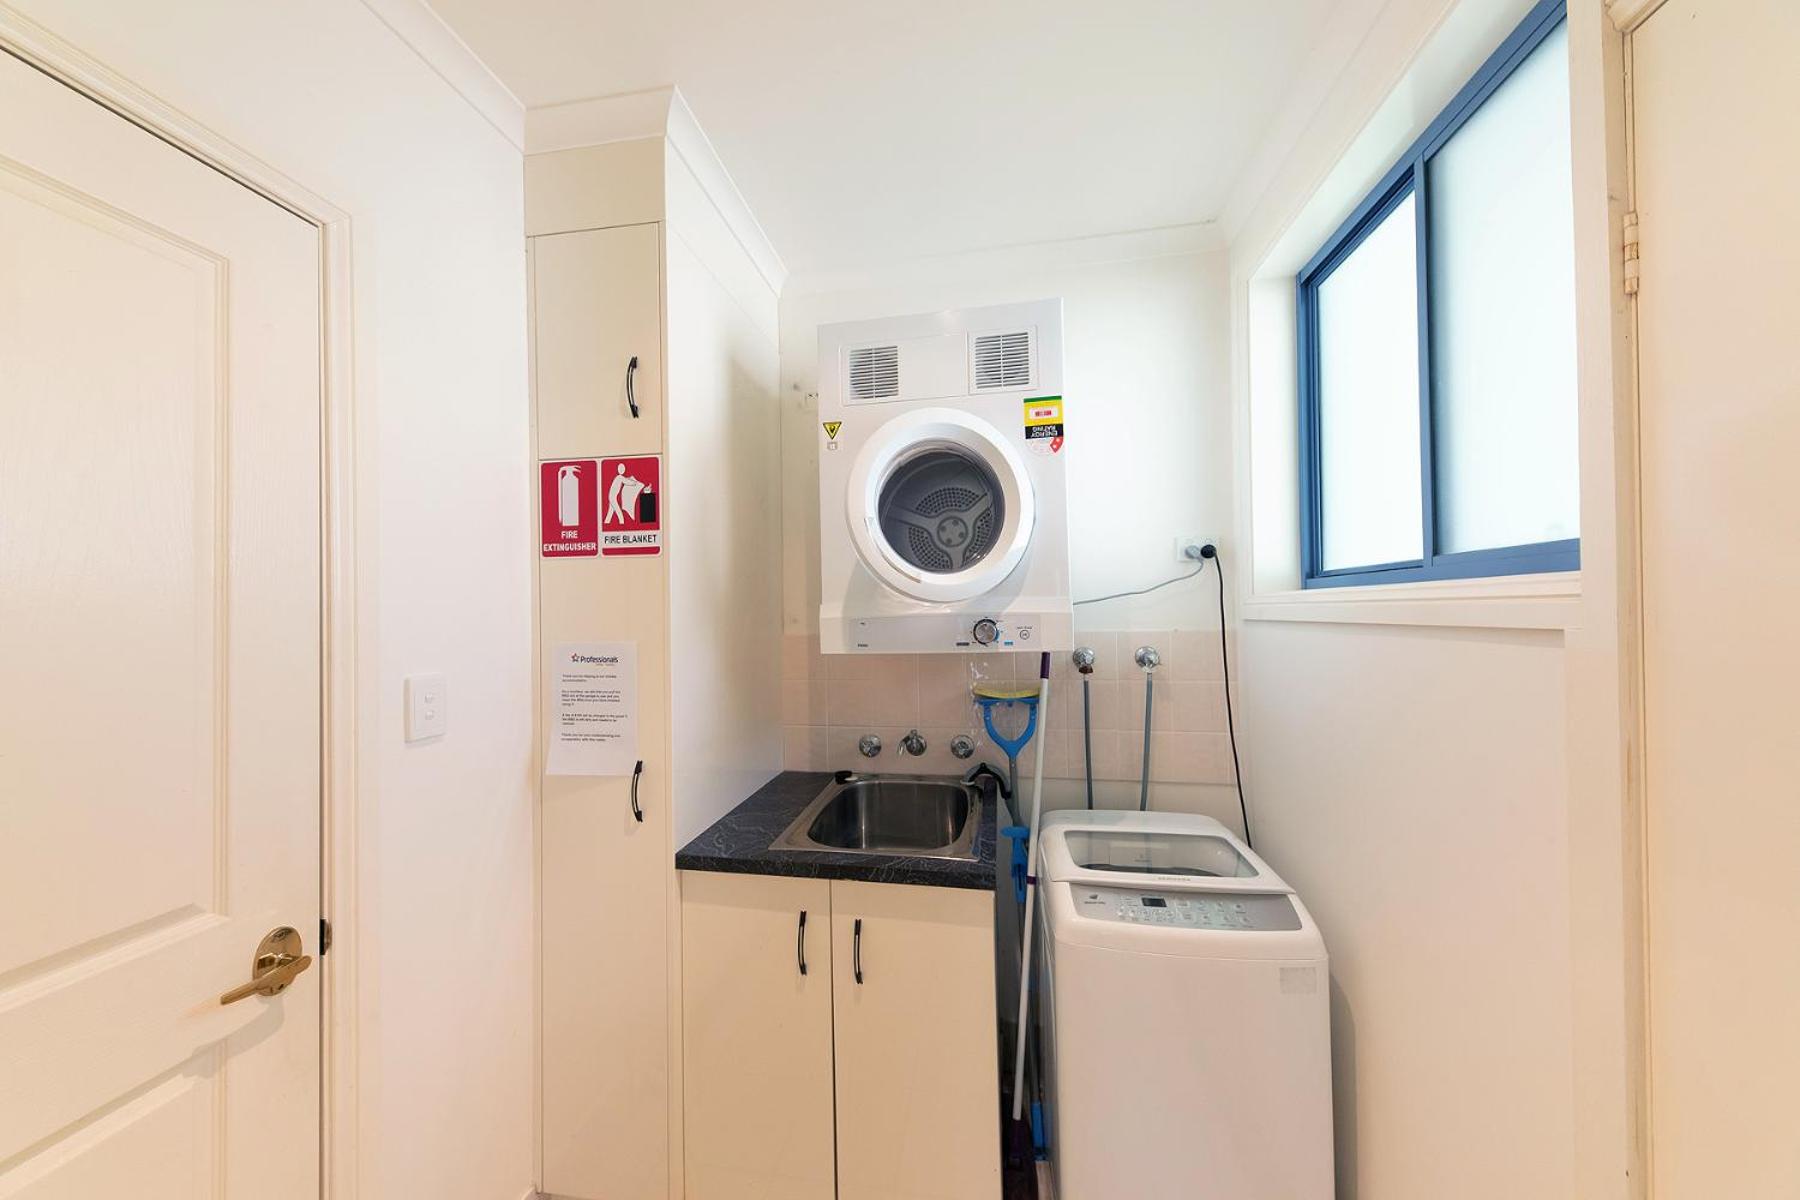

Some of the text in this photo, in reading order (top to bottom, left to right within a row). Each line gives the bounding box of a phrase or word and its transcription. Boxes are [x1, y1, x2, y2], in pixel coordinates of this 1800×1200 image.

[561, 530, 578, 539] FIRE
[604, 534, 657, 544] FIRE BLANKET
[543, 543, 597, 552] EXTINGUISHER
[580, 655, 619, 663] Professionals
